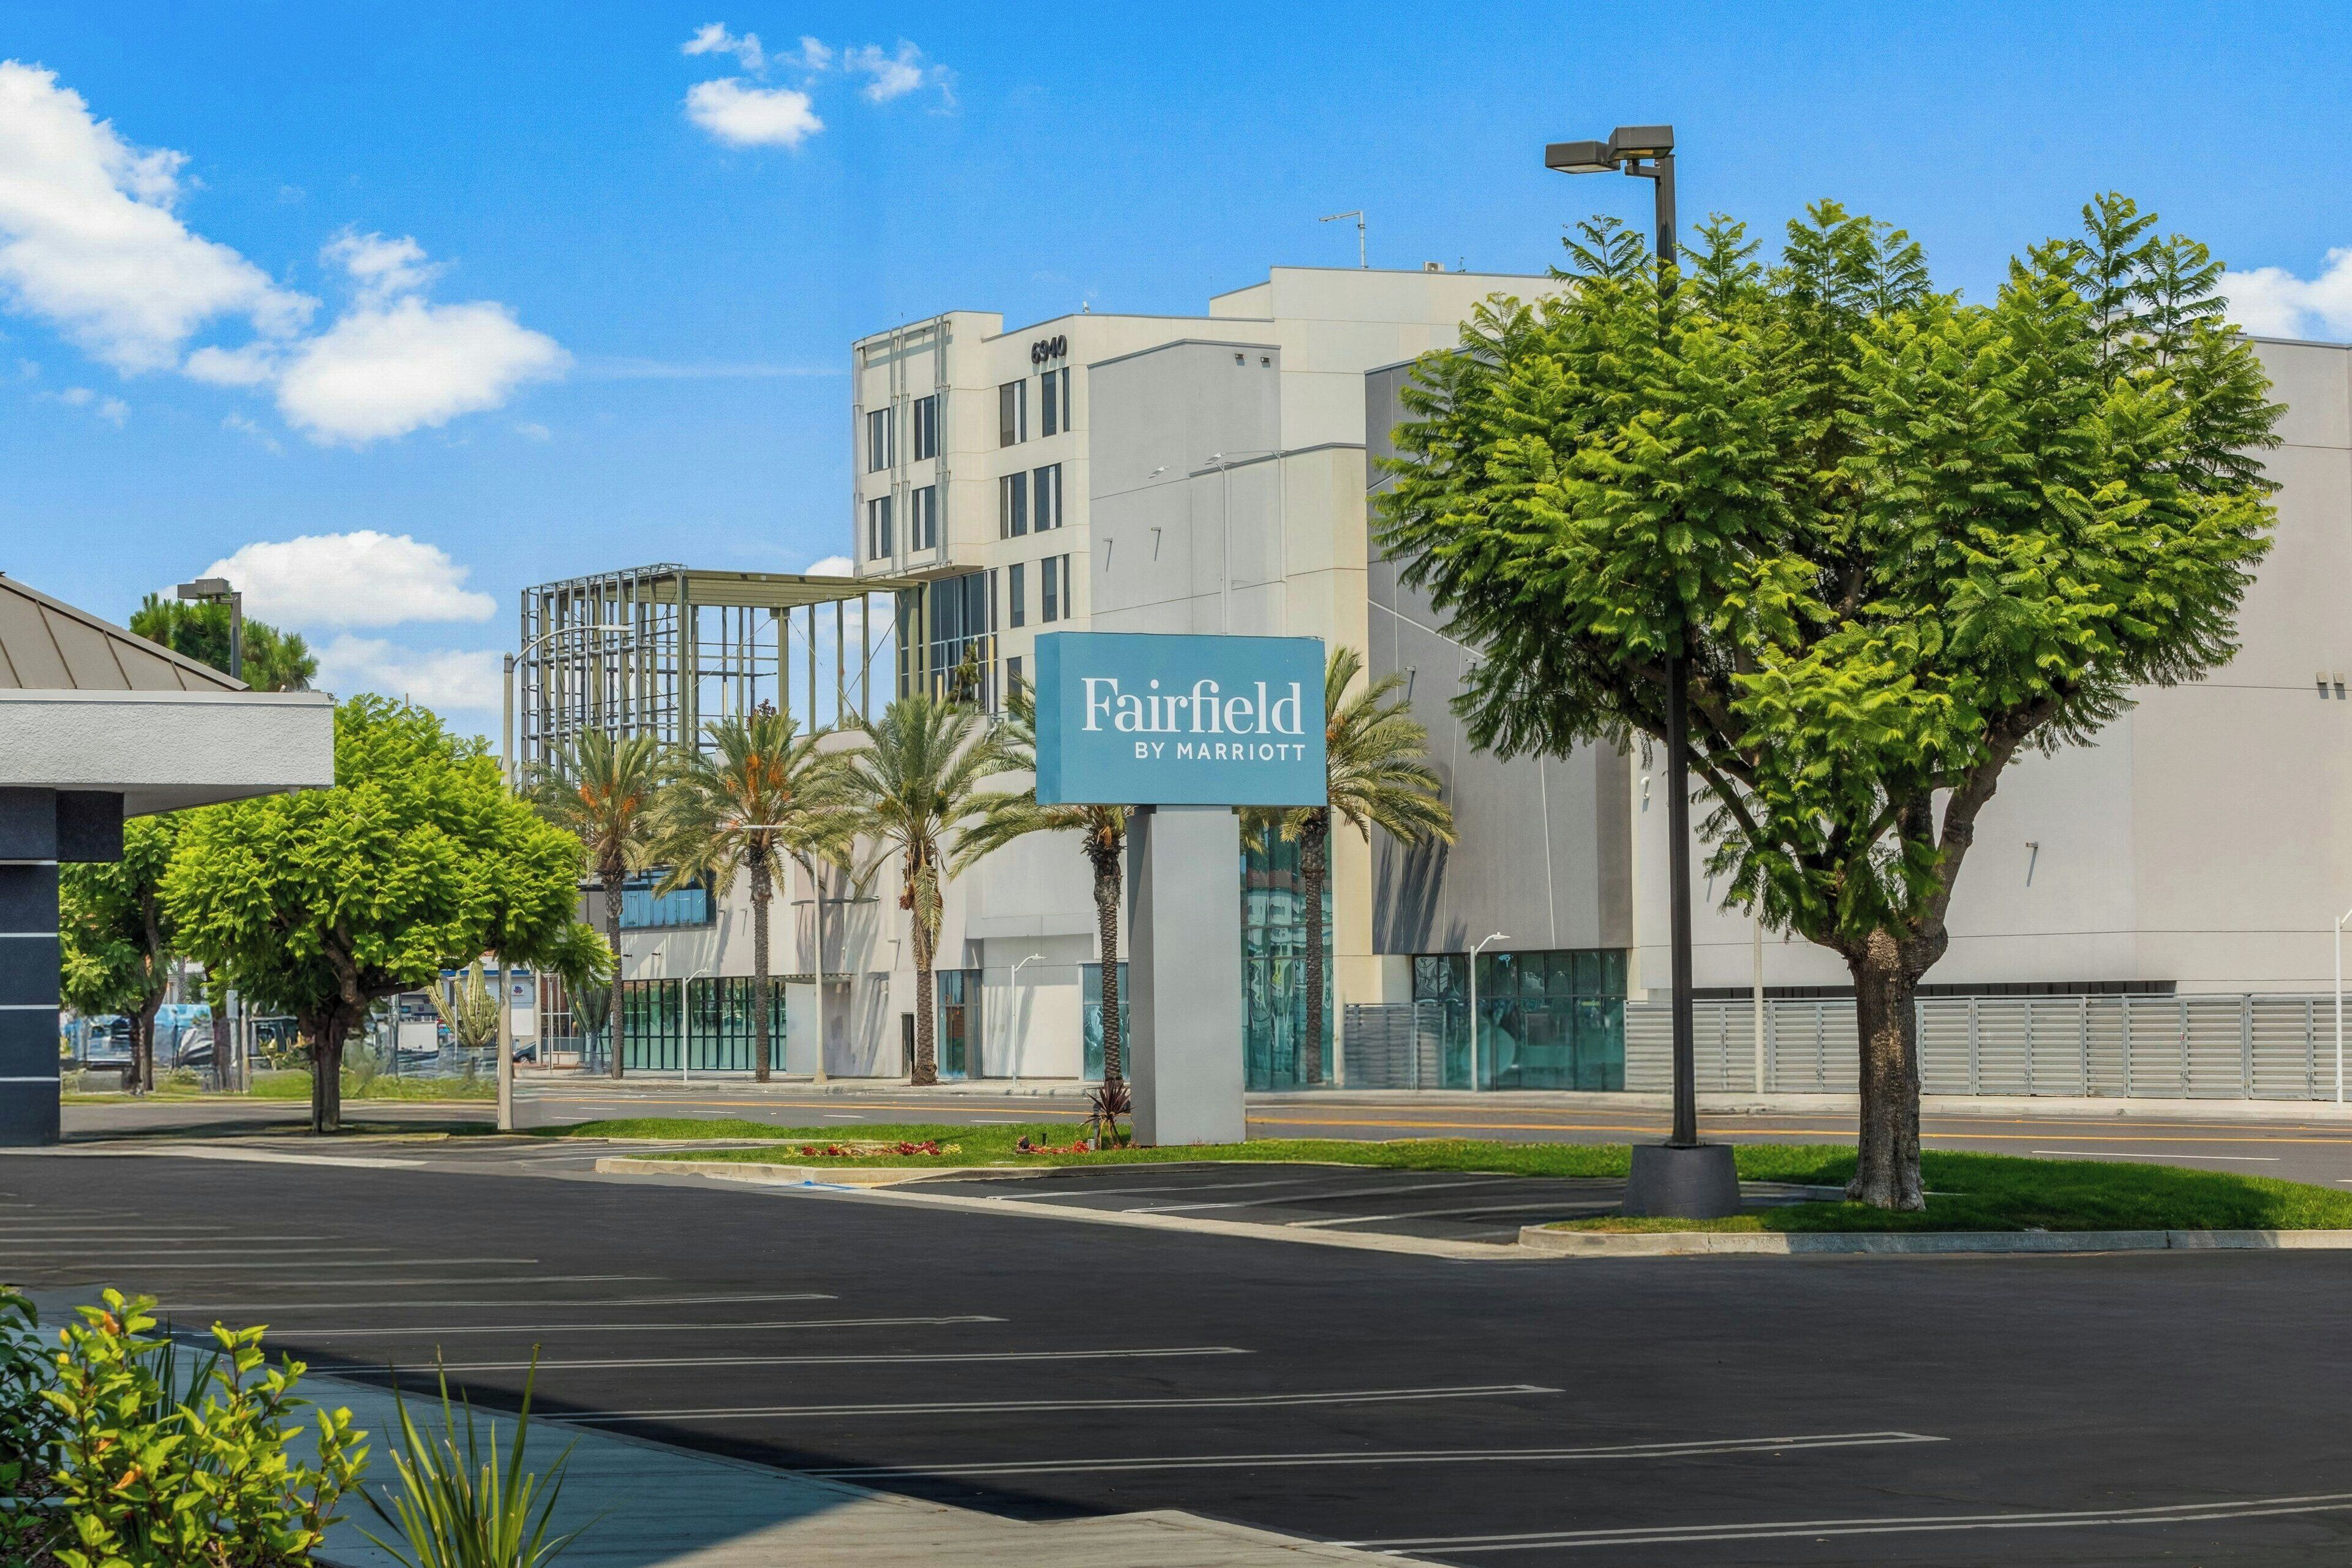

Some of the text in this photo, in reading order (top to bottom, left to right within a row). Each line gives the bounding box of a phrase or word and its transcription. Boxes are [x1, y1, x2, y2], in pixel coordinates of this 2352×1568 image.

[1031, 334, 1067, 364] 6940
[1081, 677, 1305, 735] Fairfield
[1135, 742, 1306, 761] BY MARRIOTT
